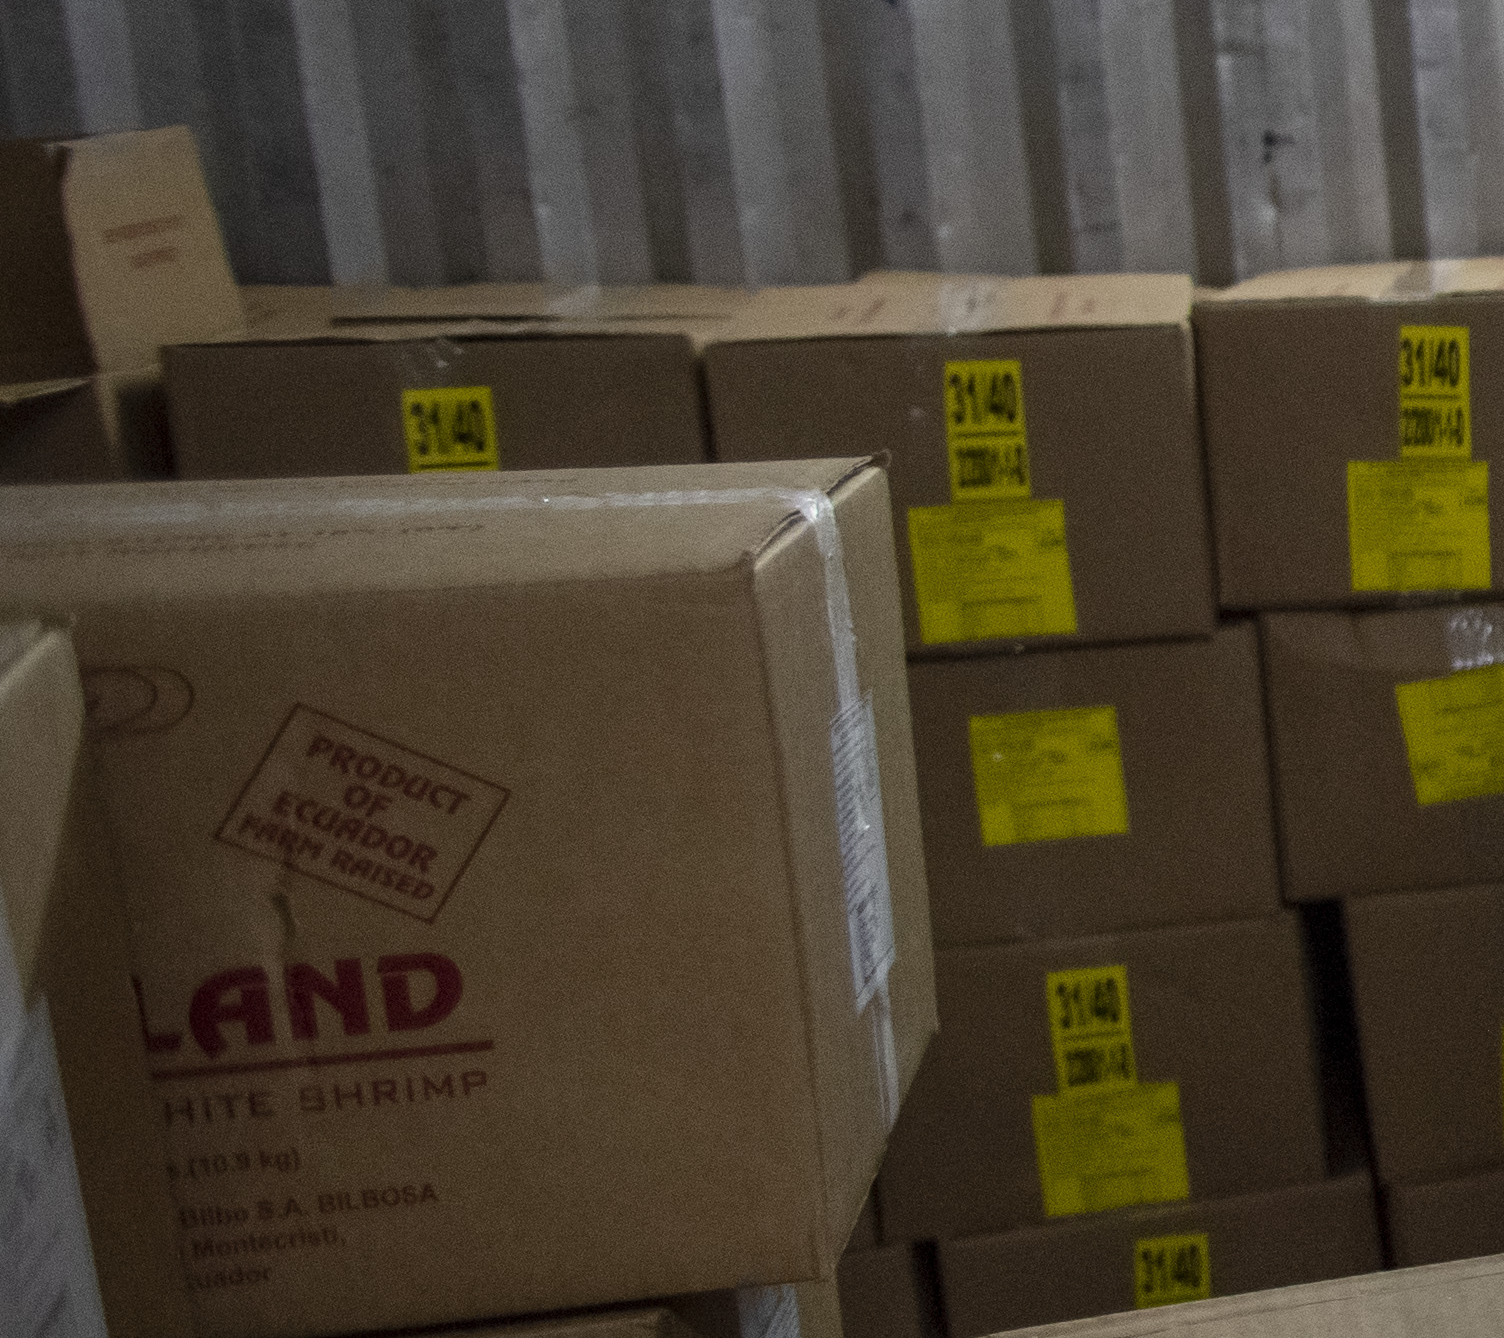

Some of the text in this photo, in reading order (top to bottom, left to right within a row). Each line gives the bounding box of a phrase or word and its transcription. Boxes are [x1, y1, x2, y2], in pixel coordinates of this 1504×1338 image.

[306, 735, 471, 815] PRODUCT
[343, 784, 393, 818] OF
[239, 814, 435, 901] FARM RAISED
[272, 790, 438, 873] ECUADOR
[164, 1070, 488, 1126] HITE SHRIMP
[316, 1182, 439, 1214] BILBOSA
